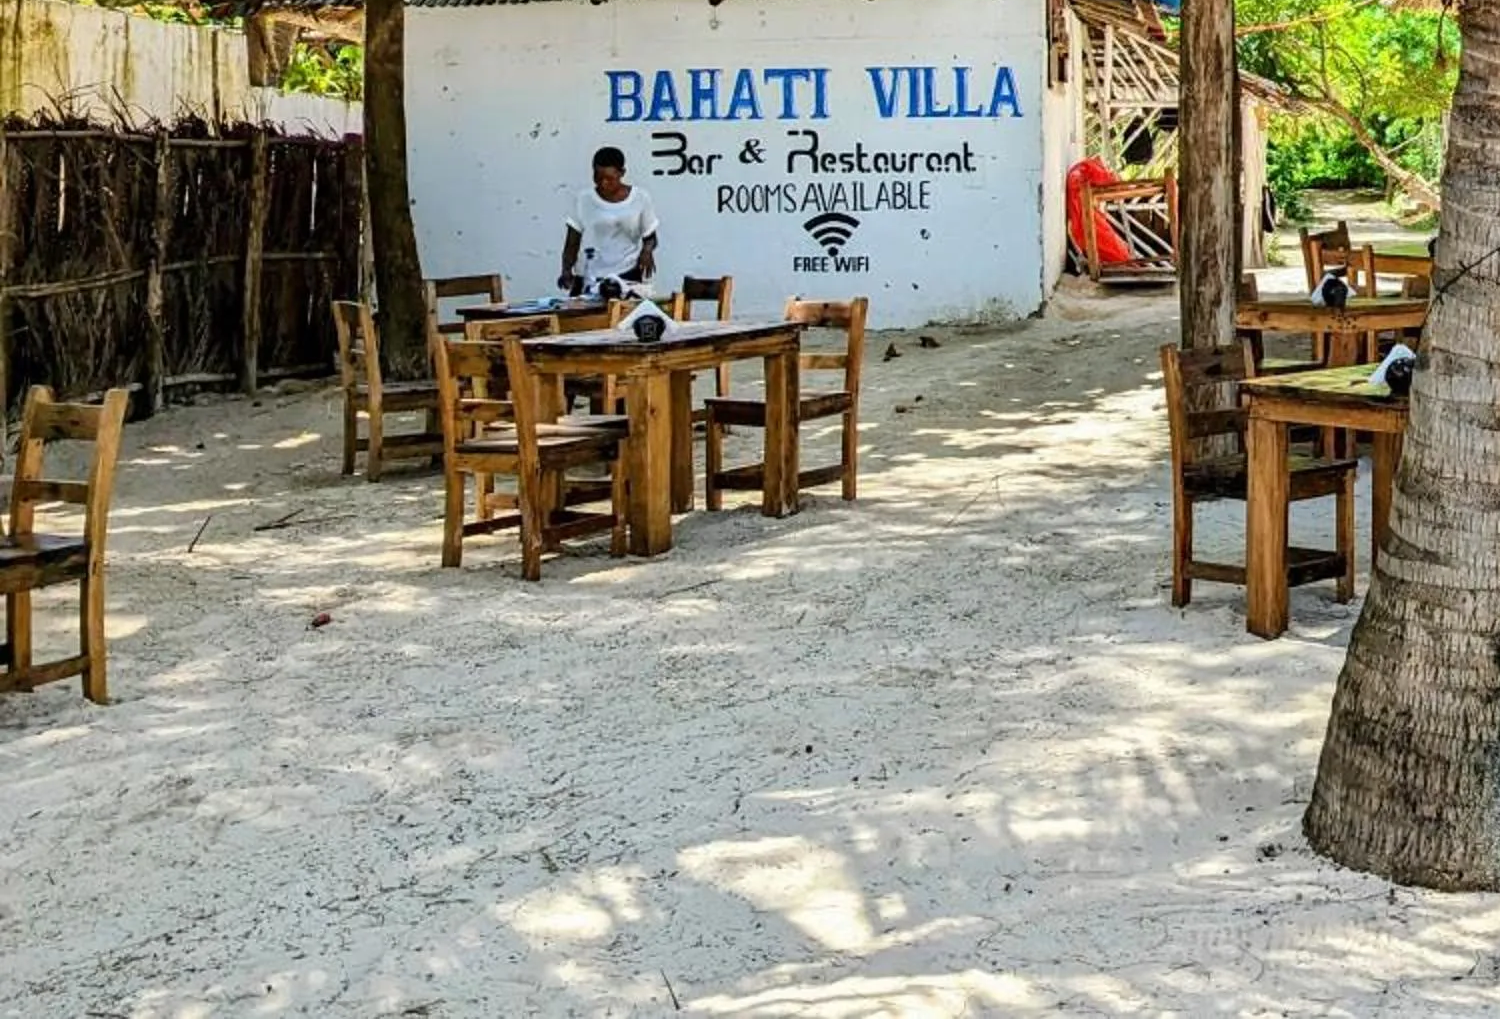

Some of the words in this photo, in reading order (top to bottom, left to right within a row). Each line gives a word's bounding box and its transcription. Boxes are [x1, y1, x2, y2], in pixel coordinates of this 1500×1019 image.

[605, 68, 831, 122] BAHATI
[866, 67, 1023, 118] VILLA
[739, 138, 766, 164] &
[787, 129, 976, 174] Restaurant
[717, 184, 797, 213] ROOMS
[801, 180, 931, 212] AVAILABLE
[793, 256, 829, 272] FREE
